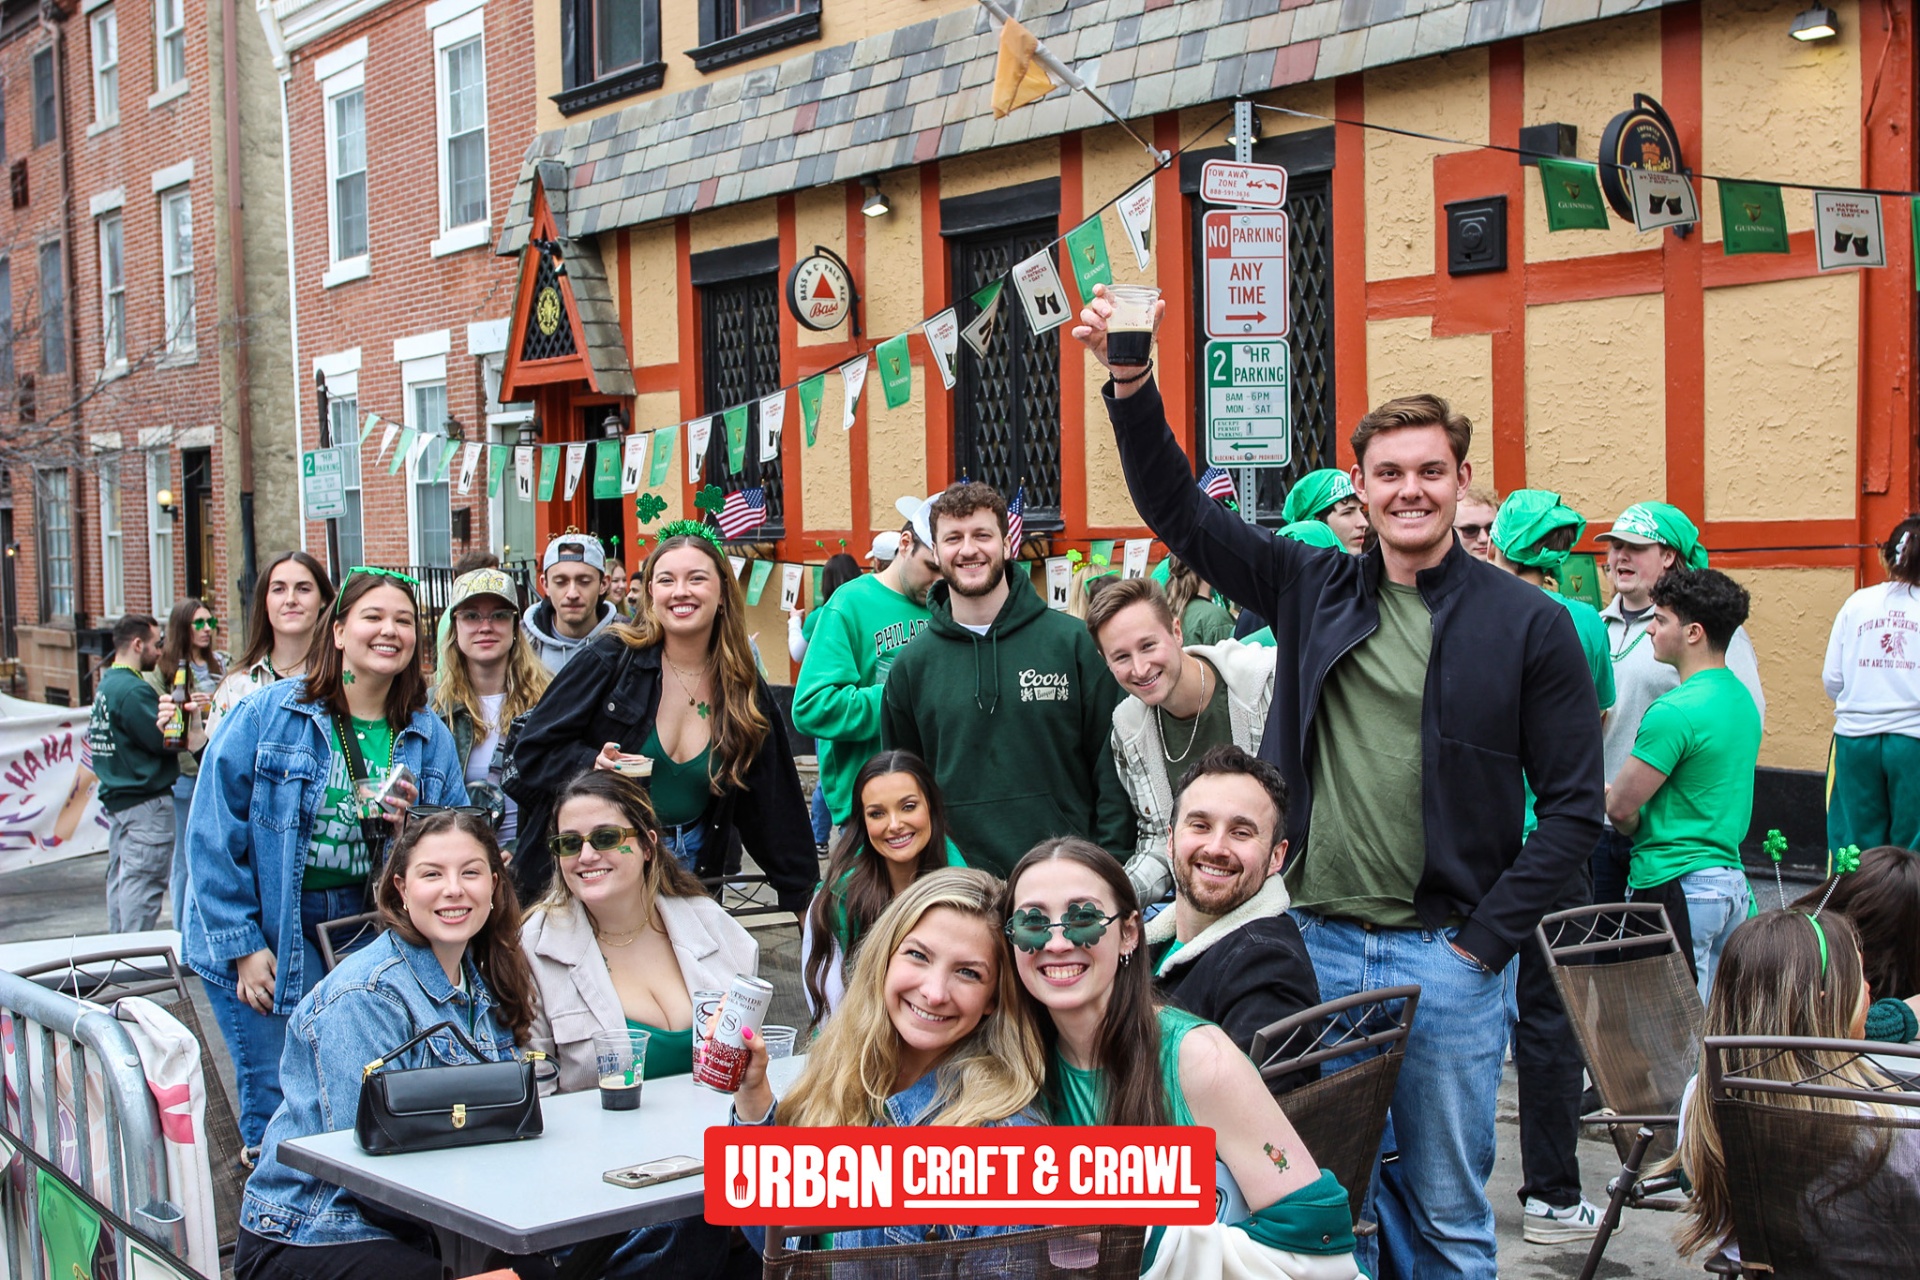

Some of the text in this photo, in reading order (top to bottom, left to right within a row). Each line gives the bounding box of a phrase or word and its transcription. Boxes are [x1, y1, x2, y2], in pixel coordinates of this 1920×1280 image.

[1208, 168, 1250, 179] TOW AWAY
[1218, 178, 1237, 188] ZONE
[1557, 201, 1595, 210] GUINNESS
[1208, 225, 1282, 248] NO PARKING
[1734, 224, 1775, 234] GUINNESS
[1229, 262, 1264, 281] ANY
[800, 278, 808, 301] BASS
[824, 264, 841, 282] PALE
[1228, 286, 1266, 305] TIME
[810, 302, 839, 318] Bass
[1212, 346, 1270, 381] 2 HR
[1234, 366, 1284, 383] PARKING
[1225, 392, 1243, 402] 8AM
[1251, 391, 1270, 401] 6PM
[1225, 404, 1244, 413] MON
[1254, 404, 1271, 414] SAT
[305, 456, 313, 474] 2
[316, 462, 340, 472] PARKING
[1863, 619, 1874, 632] YOU
[1874, 618, 1891, 628] AIN'T
[873, 620, 930, 657] PHILAD
[1858, 658, 1916, 670] HAT ARE YOU DOING?
[1018, 668, 1069, 688] Coors
[722, 1014, 738, 1032] S
